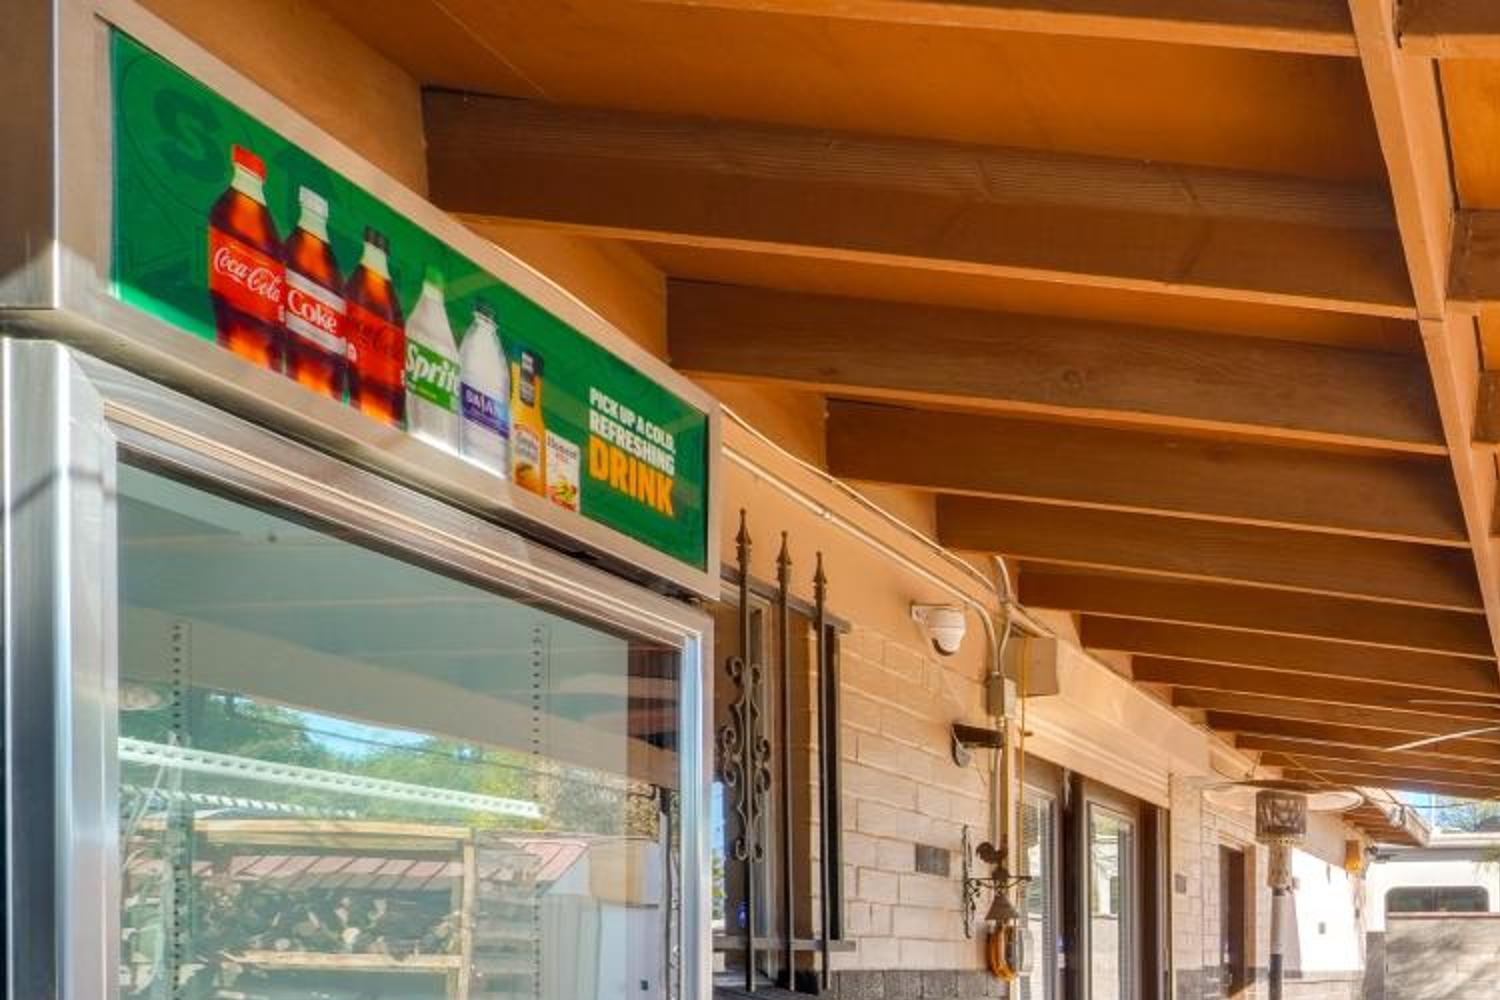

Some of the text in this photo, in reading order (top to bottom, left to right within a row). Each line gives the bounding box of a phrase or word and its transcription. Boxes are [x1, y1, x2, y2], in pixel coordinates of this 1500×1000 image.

[288, 289, 337, 333] Coke
[590, 386, 619, 419] PICK
[620, 404, 636, 428] UP
[636, 415, 645, 435] A
[590, 408, 674, 476] REFRESHING
[589, 434, 673, 516] DRINK
